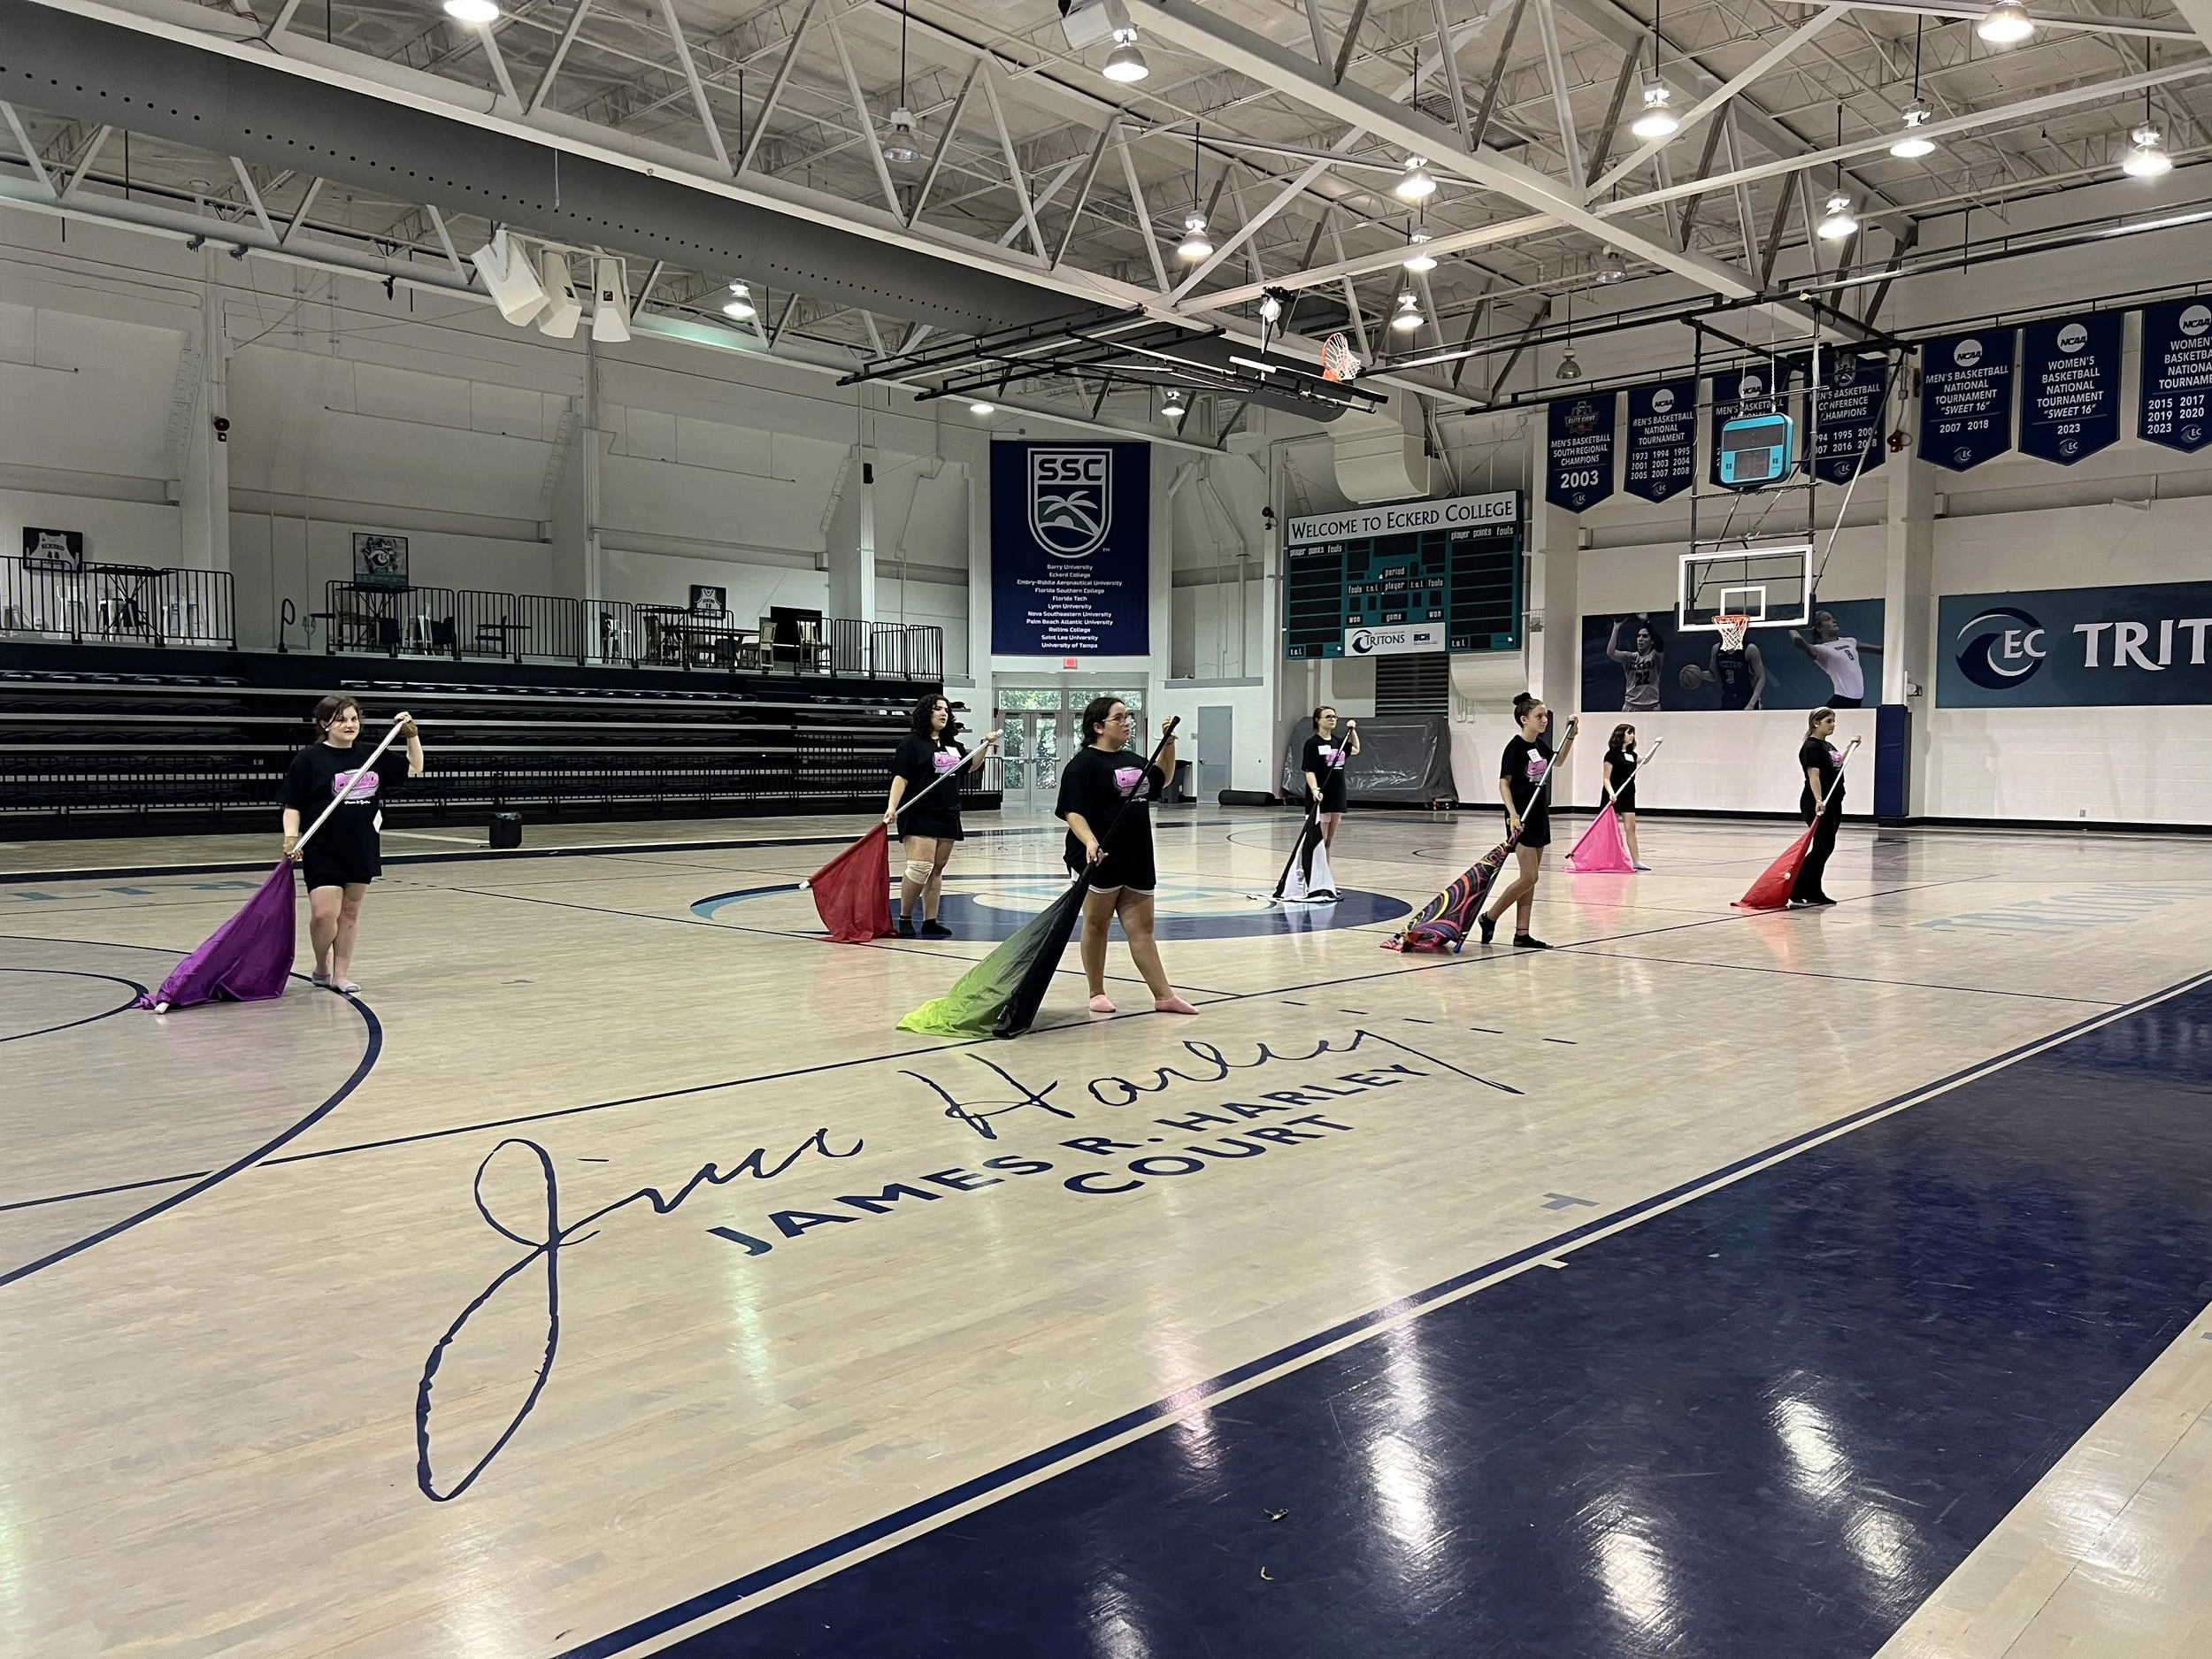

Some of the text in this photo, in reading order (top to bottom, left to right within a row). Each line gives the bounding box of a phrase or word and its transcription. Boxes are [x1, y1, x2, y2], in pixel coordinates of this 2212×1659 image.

[2183, 318, 2211, 329] NCAA
[2061, 336, 2086, 347] NCAA
[1956, 350, 1982, 361] NCAA
[2048, 356, 2094, 371] WOMEN'S
[1925, 365, 2008, 384] MEN'S BASKETBALL
[2042, 367, 2101, 384] BASKETBALL
[1809, 383, 1880, 402] EN'S BASKETBALL
[1944, 380, 1989, 393] NATIONAL
[2047, 380, 2095, 395] NATIONAL
[1655, 399, 1673, 408] NCAA
[1935, 389, 1998, 404] TOURNAMENT
[2037, 390, 2104, 408] TOURNAMENT
[2148, 395, 2205, 410] 2015 2017
[1716, 398, 1784, 415] MEN'S ASKETBLL
[1633, 411, 1694, 426] MEN'S BASKETBALL
[2148, 407, 2204, 422] 2019 2020
[1644, 424, 1678, 435] NATIONAL
[1939, 419, 1989, 434] 2007 2018
[2057, 423, 2080, 434] 2023
[2147, 423, 2172, 434] 2023
[2191, 427, 2201, 436] EC
[1551, 434, 1610, 448] MEN'S BASKETBALL
[1639, 432, 1685, 445] TOURNAMENT
[1833, 430, 1853, 440] 1995
[1553, 443, 1608, 457] SOUTH REGIONAL
[1832, 442, 1852, 452] 2016
[1858, 438, 1877, 449] 208
[2069, 442, 2078, 450] EC
[1561, 454, 1600, 466] CHAMPIONS
[1653, 449, 1670, 459] 1994
[1674, 447, 1690, 457] 1995
[1037, 458, 1103, 481] SSC
[1632, 457, 1690, 471] 2001 2003 2004
[1560, 470, 1599, 488] 2003
[1651, 469, 1669, 479] 2007
[1672, 466, 1690, 476] 2008
[1292, 501, 1513, 539] WELCOME TO ECKERD COLLEGE
[1451, 526, 1514, 541] player points fouls
[1309, 546, 1325, 556] points
[1327, 544, 1342, 553] fouls
[1385, 567, 1405, 578] period
[1348, 585, 1363, 594] fouls
[1385, 582, 1405, 592] player
[1428, 578, 1443, 588] fouls
[1386, 613, 1402, 623] game
[1363, 634, 1405, 646] TRITONS
[2004, 618, 2212, 671] EC TRIT
[705, 1153, 1054, 1256] JAMES
[1153, 1063, 1431, 1132] HARLEY
[1063, 1113, 1354, 1195] COURT
